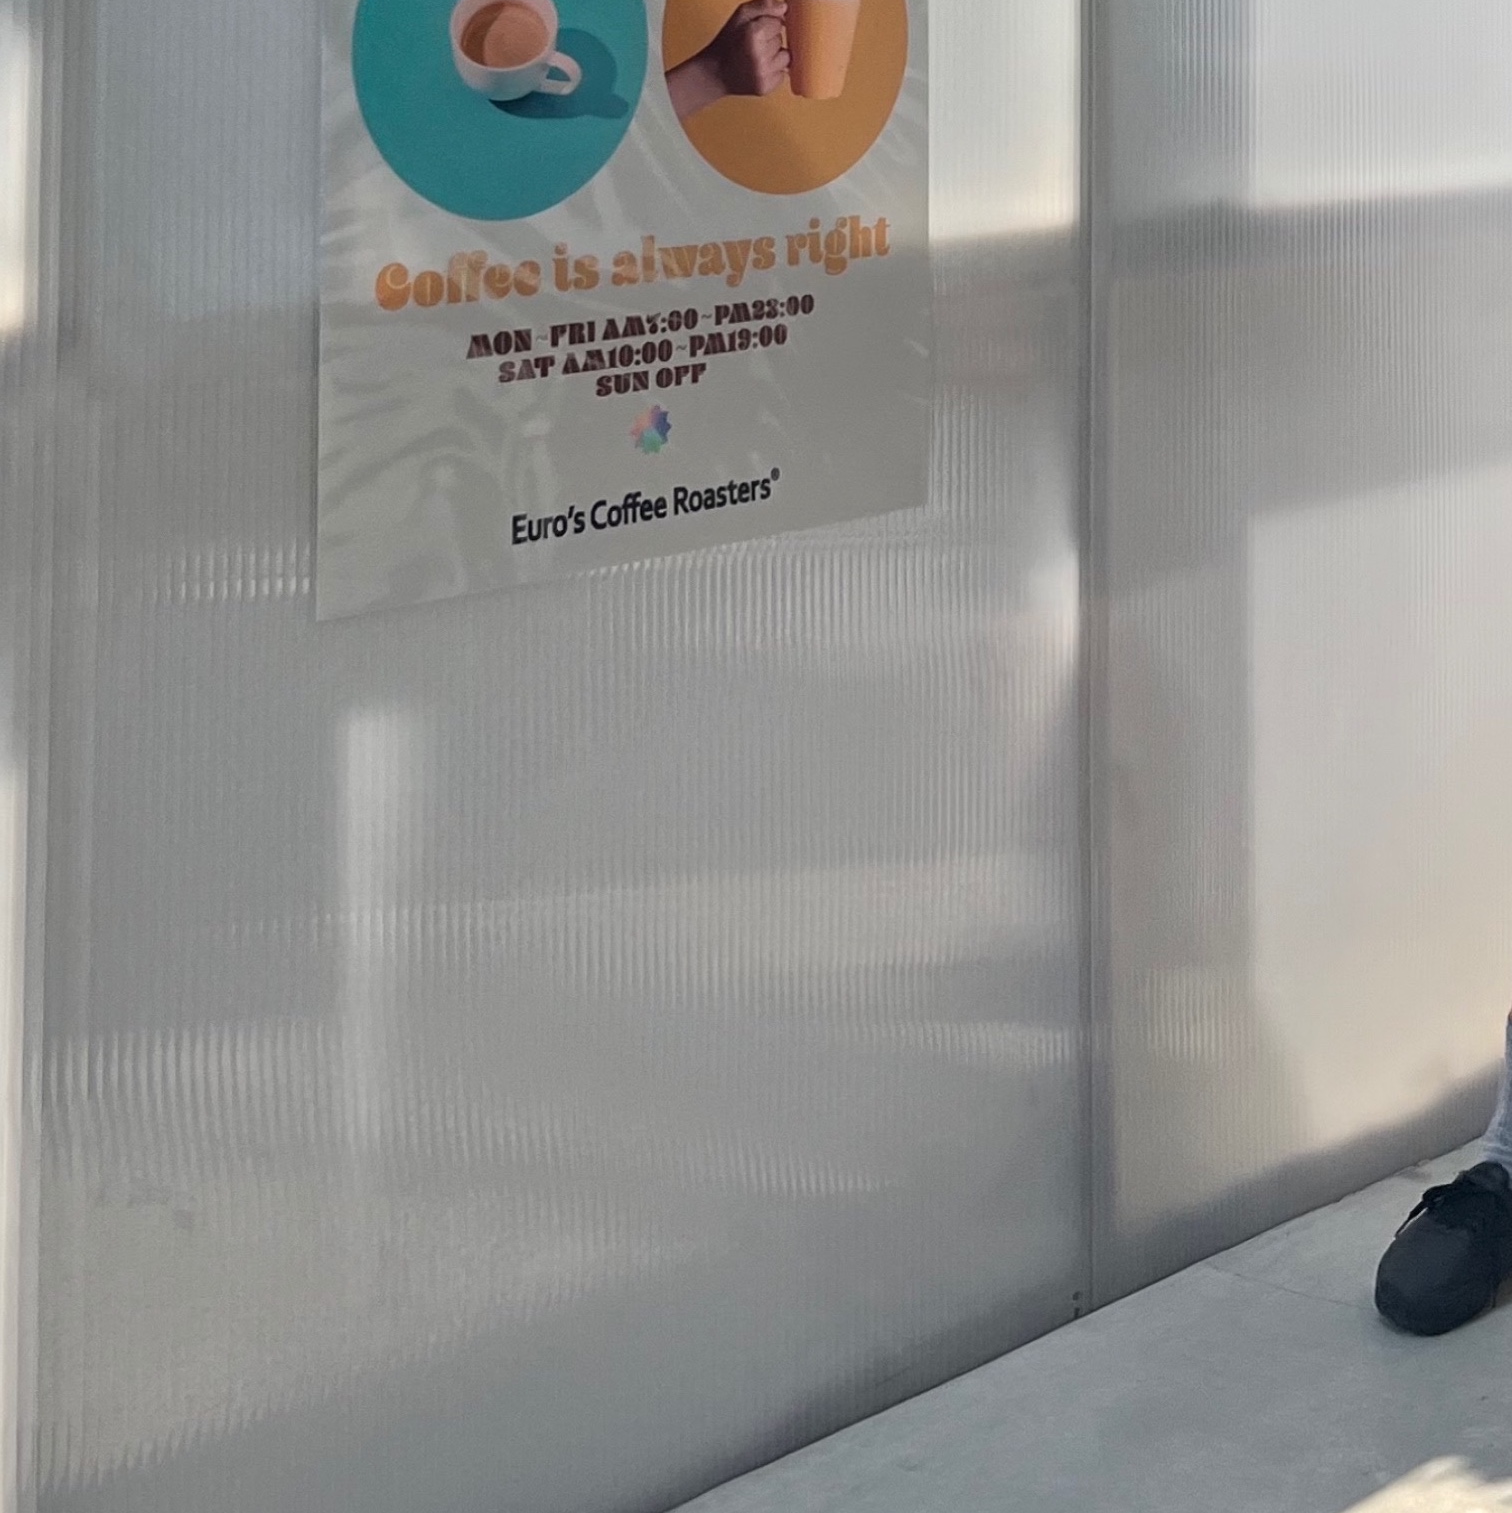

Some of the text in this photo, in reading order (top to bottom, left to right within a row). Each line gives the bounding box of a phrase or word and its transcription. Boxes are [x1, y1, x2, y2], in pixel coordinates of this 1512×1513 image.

[375, 215, 890, 311] Coffee is always right
[498, 355, 556, 383] SAT
[596, 362, 707, 397] SUN OFF
[590, 492, 667, 530] Coffee
